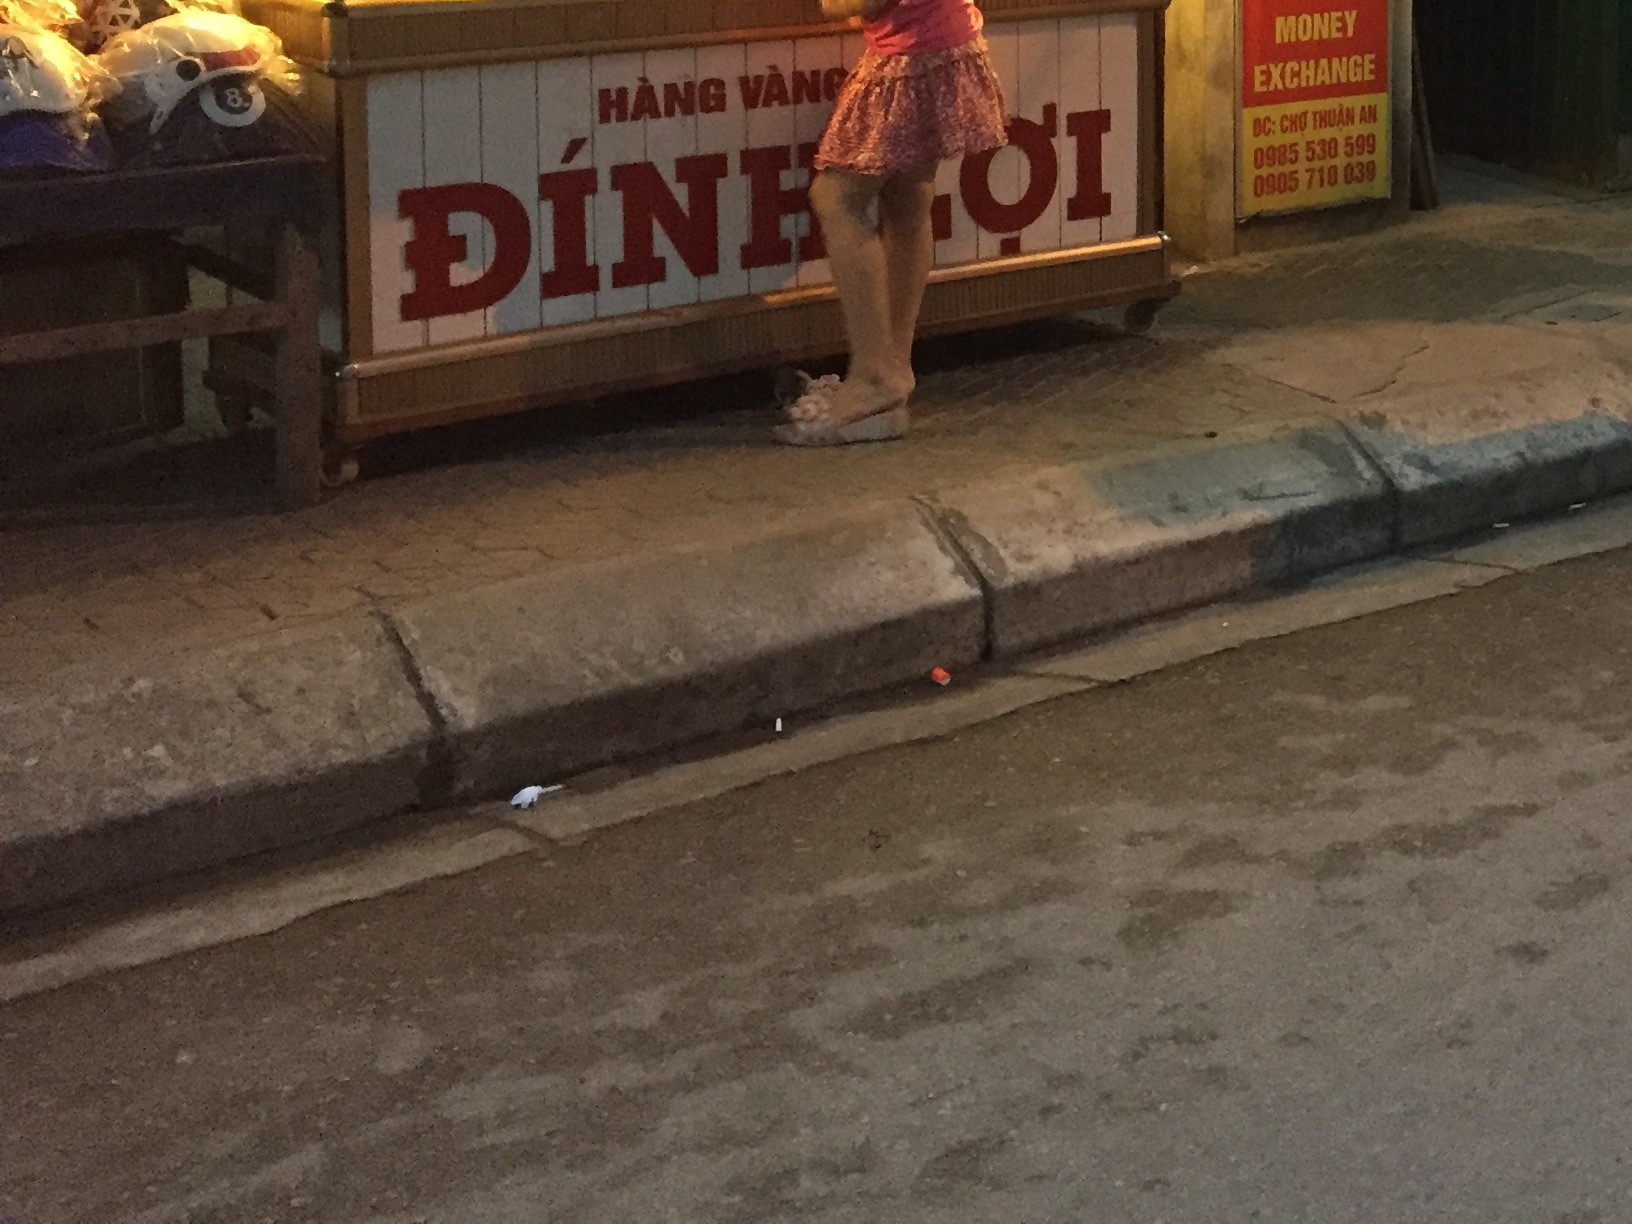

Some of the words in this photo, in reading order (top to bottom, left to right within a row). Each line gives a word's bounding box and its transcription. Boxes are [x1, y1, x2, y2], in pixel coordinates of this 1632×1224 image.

[1275, 10, 1357, 44] MONEY
[1253, 53, 1376, 93] EXCHANGE
[598, 76, 727, 124] HÀNG
[1280, 110, 1309, 136] CHỢ
[1312, 104, 1355, 132] THUẬN
[1359, 104, 1378, 124] AN
[1253, 142, 1300, 170] 0985
[1305, 137, 1339, 162] 530
[1344, 133, 1377, 158] 599
[930, 102, 1112, 256] ỢI
[1305, 165, 1339, 190] 710
